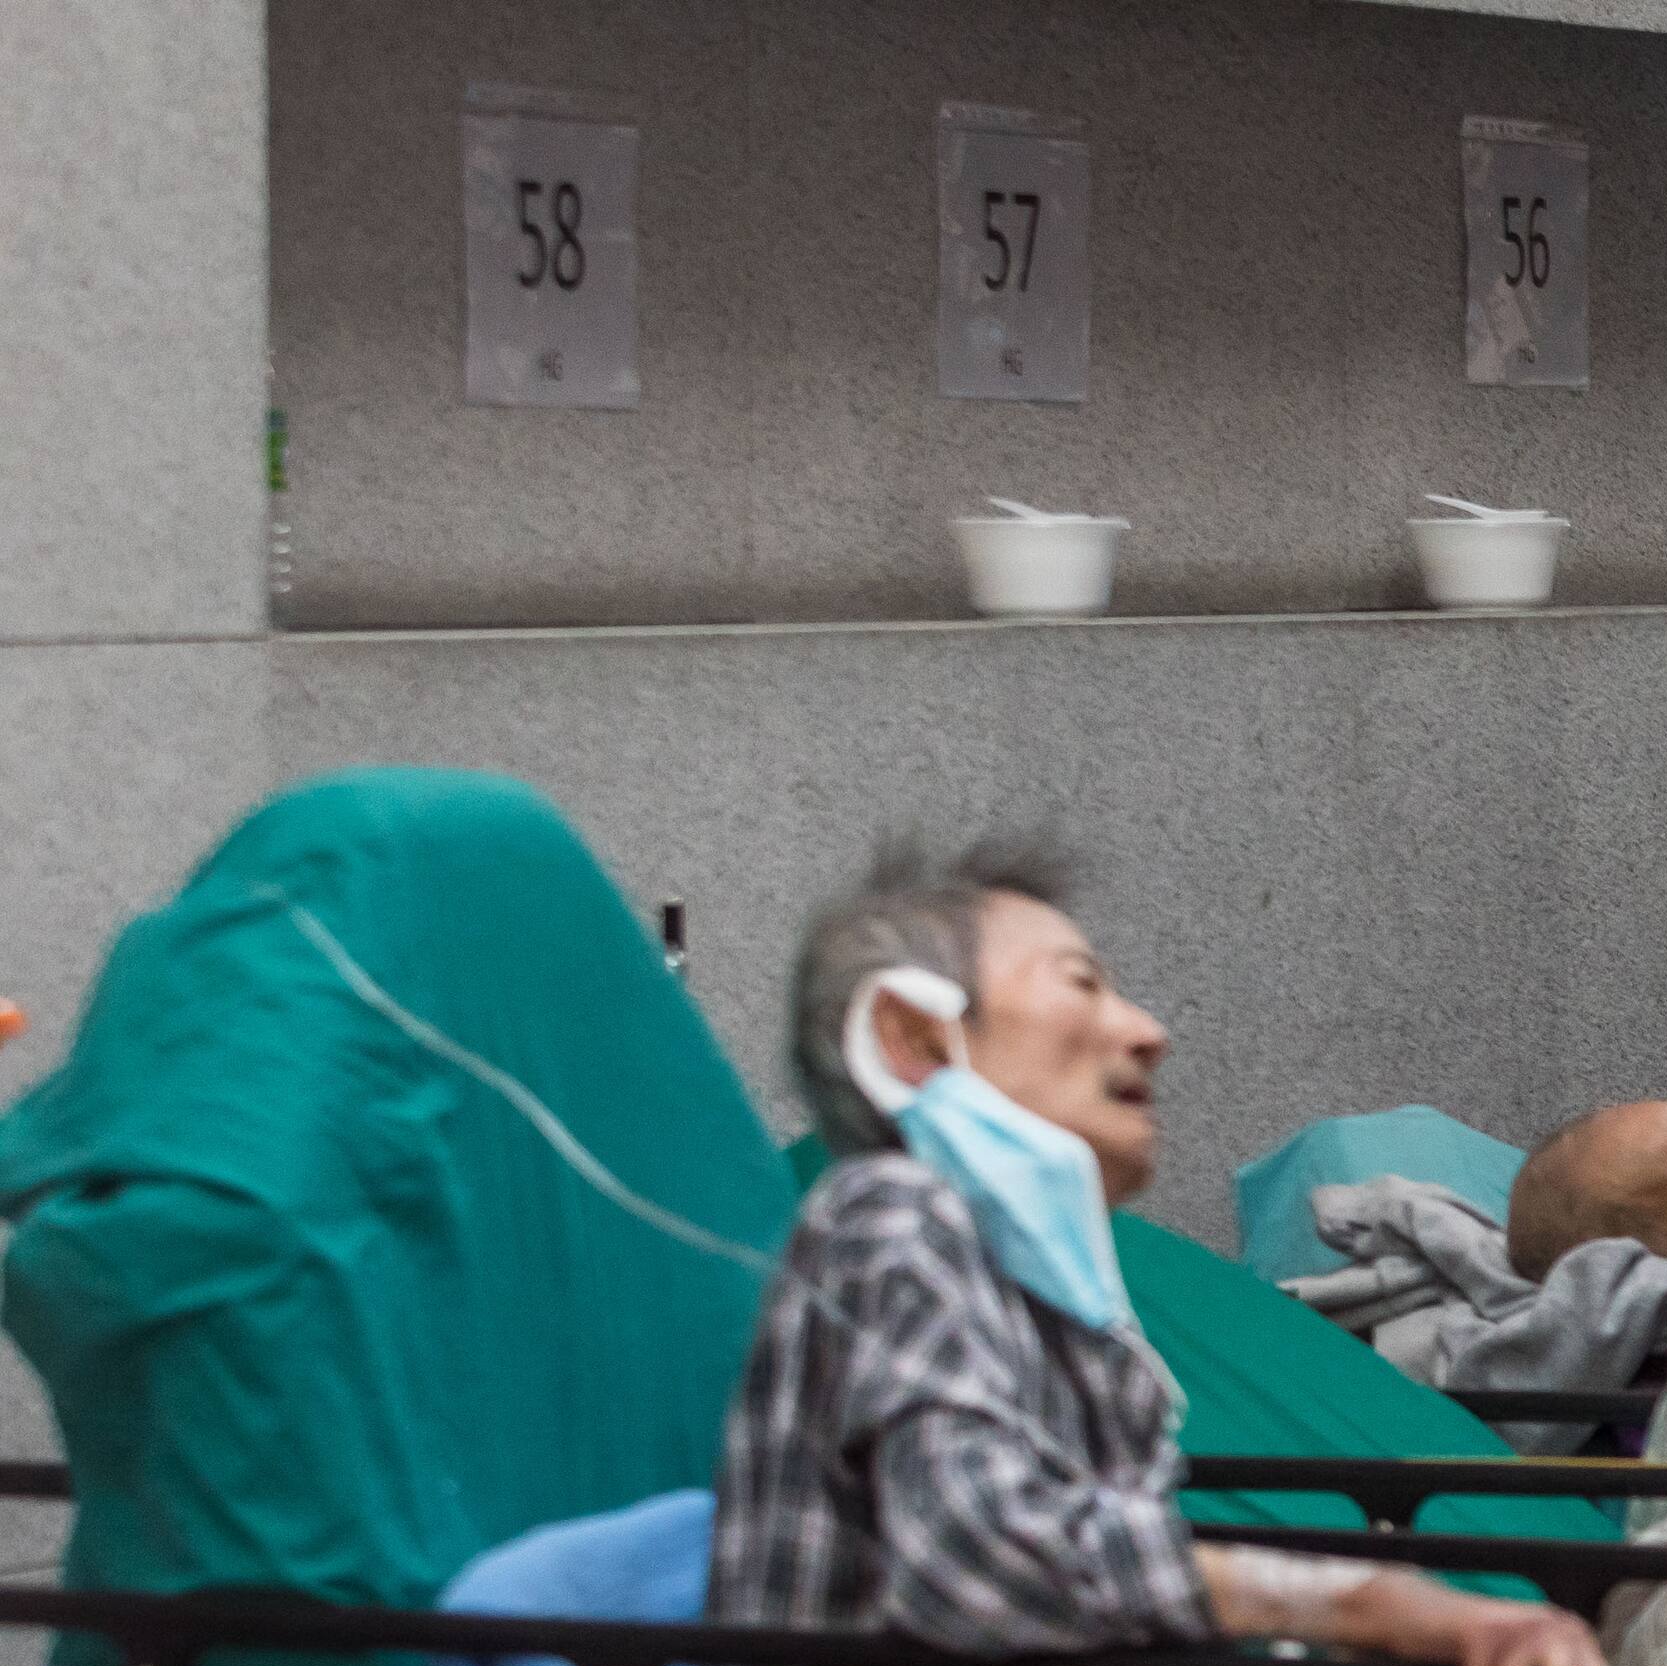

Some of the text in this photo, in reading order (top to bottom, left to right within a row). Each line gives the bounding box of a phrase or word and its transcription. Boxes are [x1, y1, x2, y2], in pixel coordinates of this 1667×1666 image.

[516, 180, 585, 290] 58
[982, 190, 1040, 291] 57
[1502, 196, 1549, 288] 56
